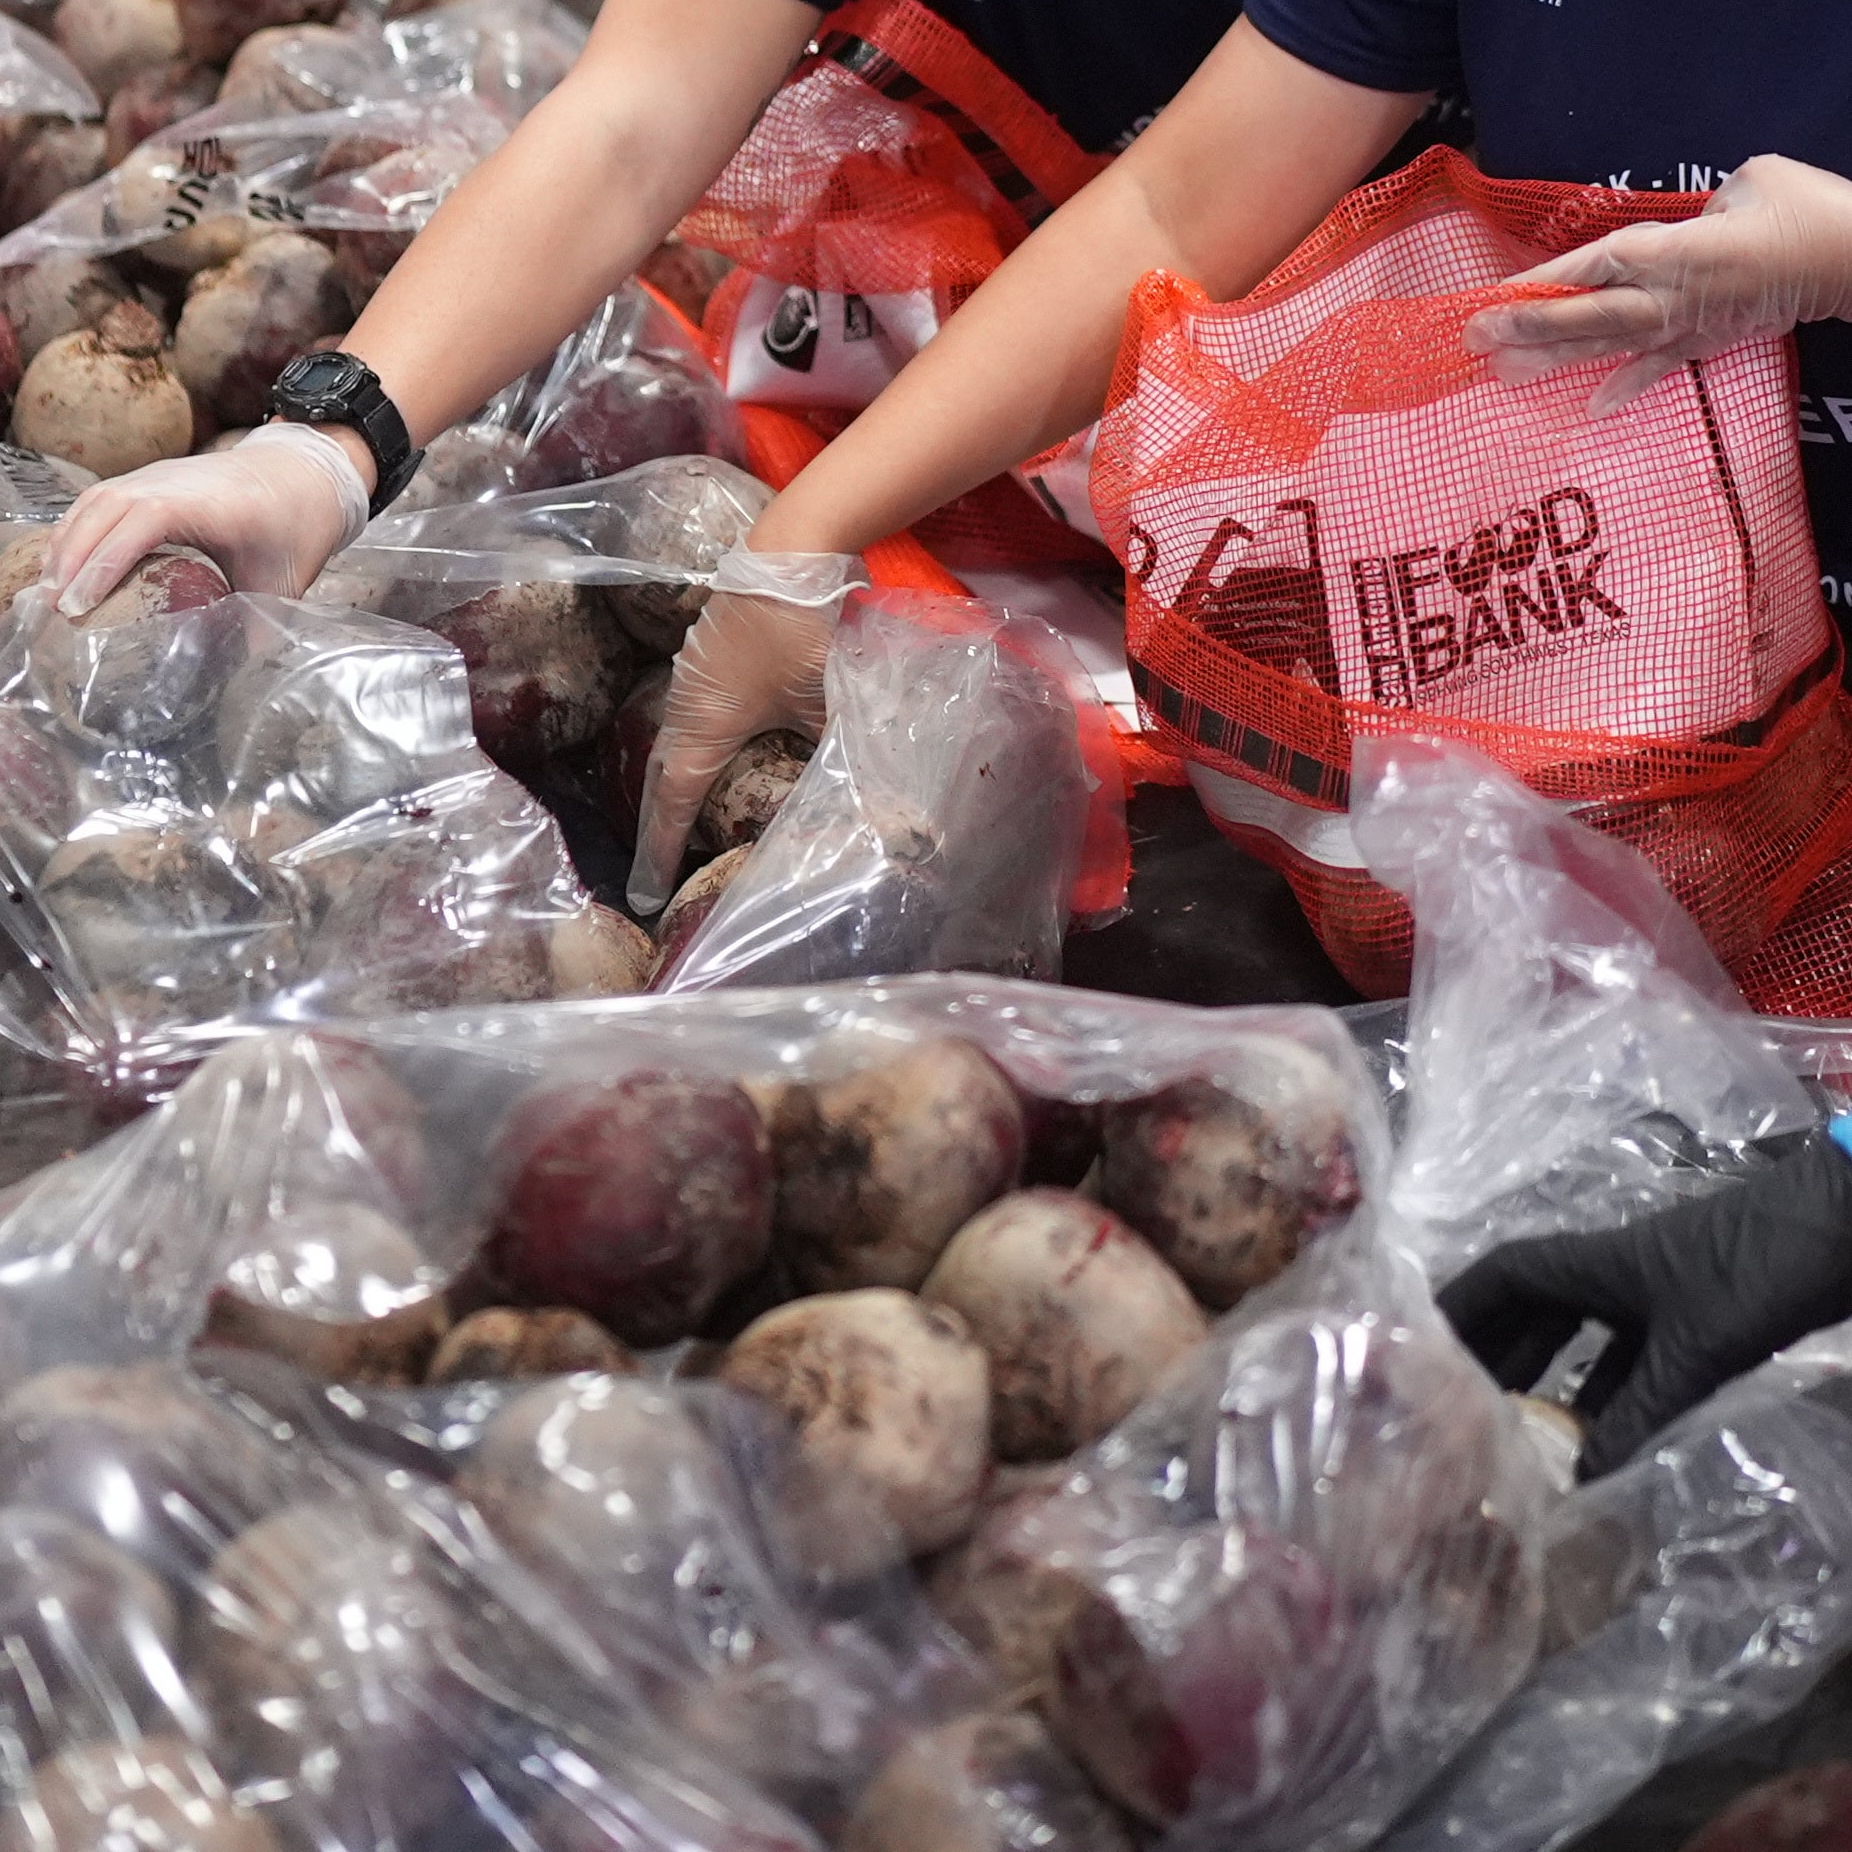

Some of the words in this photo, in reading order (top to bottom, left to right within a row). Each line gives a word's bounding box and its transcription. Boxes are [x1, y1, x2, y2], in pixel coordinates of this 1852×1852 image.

[1392, 486, 1599, 618] FOOD
[1405, 550, 1629, 686] BANK
[1579, 621, 1632, 652] TEXAS
